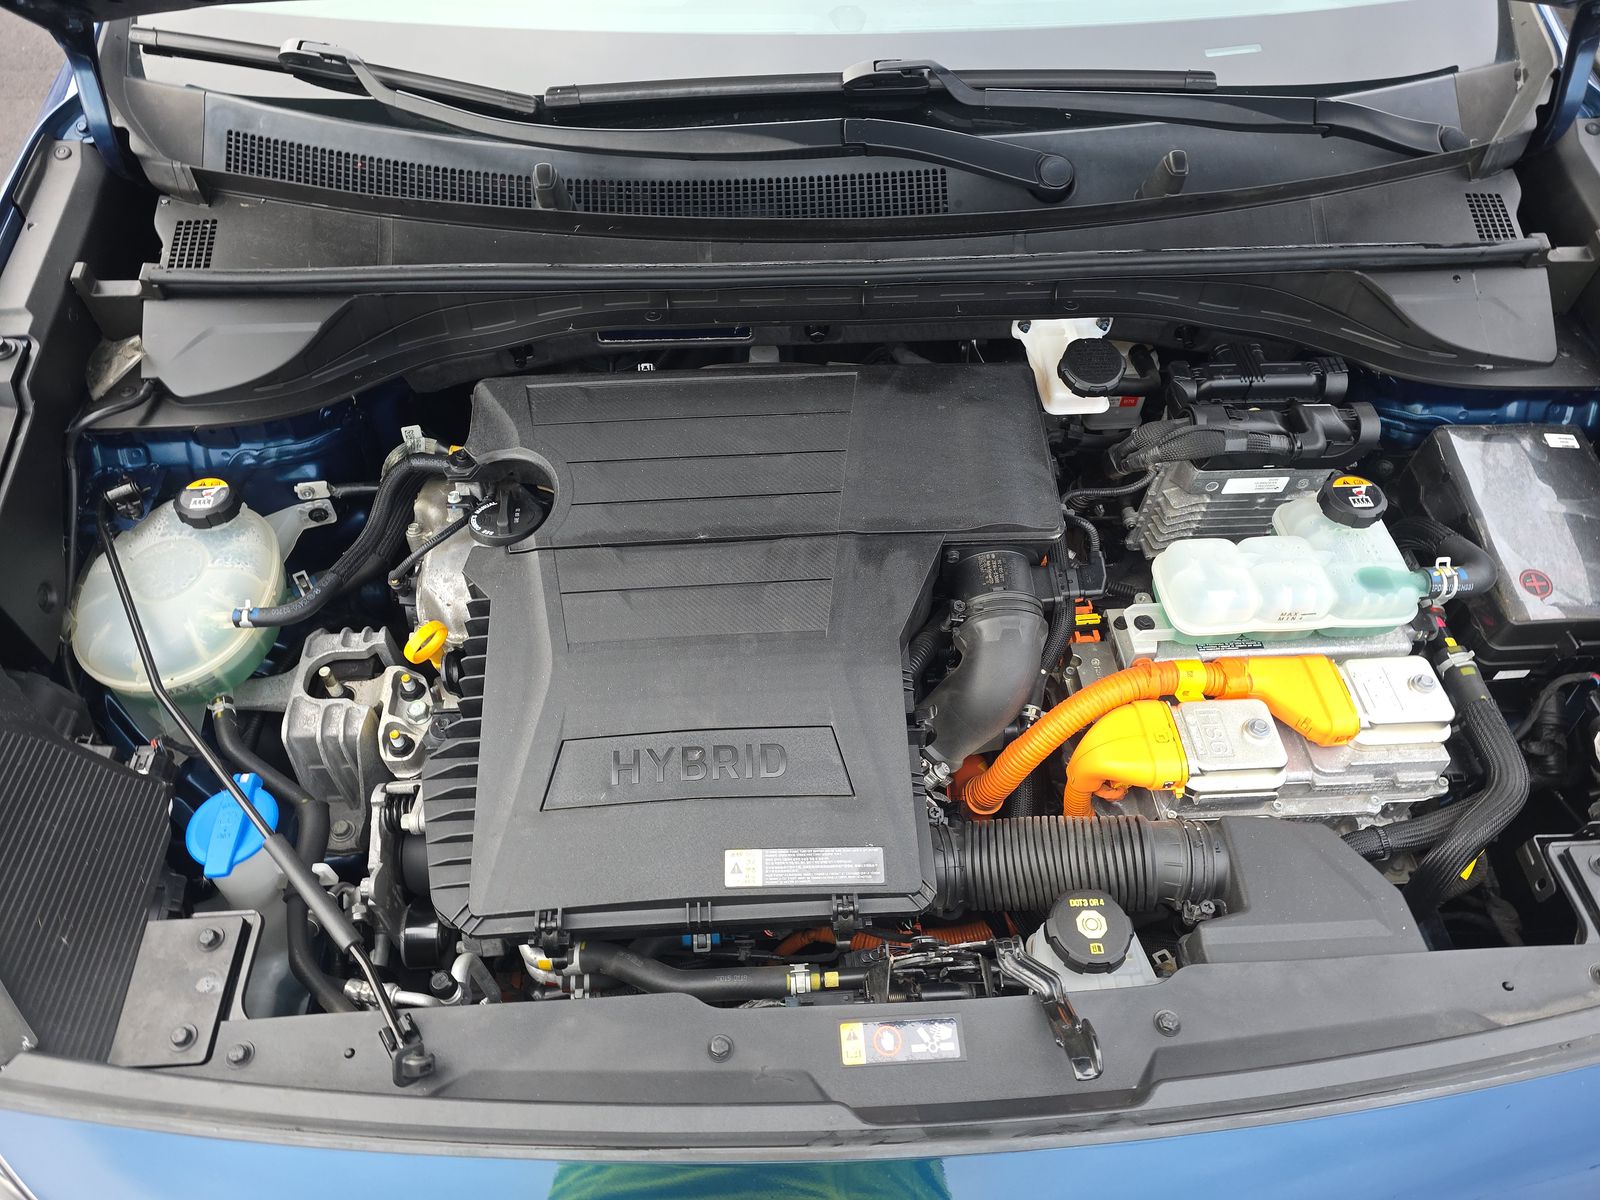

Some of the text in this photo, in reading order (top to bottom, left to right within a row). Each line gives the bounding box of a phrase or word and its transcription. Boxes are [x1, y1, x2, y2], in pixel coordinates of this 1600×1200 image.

[474, 502, 498, 514] MANUAL
[1199, 709, 1228, 753] HSG
[611, 743, 788, 786] HYBRID
[1069, 898, 1089, 907] DOT3
[1089, 898, 1099, 906] OR
